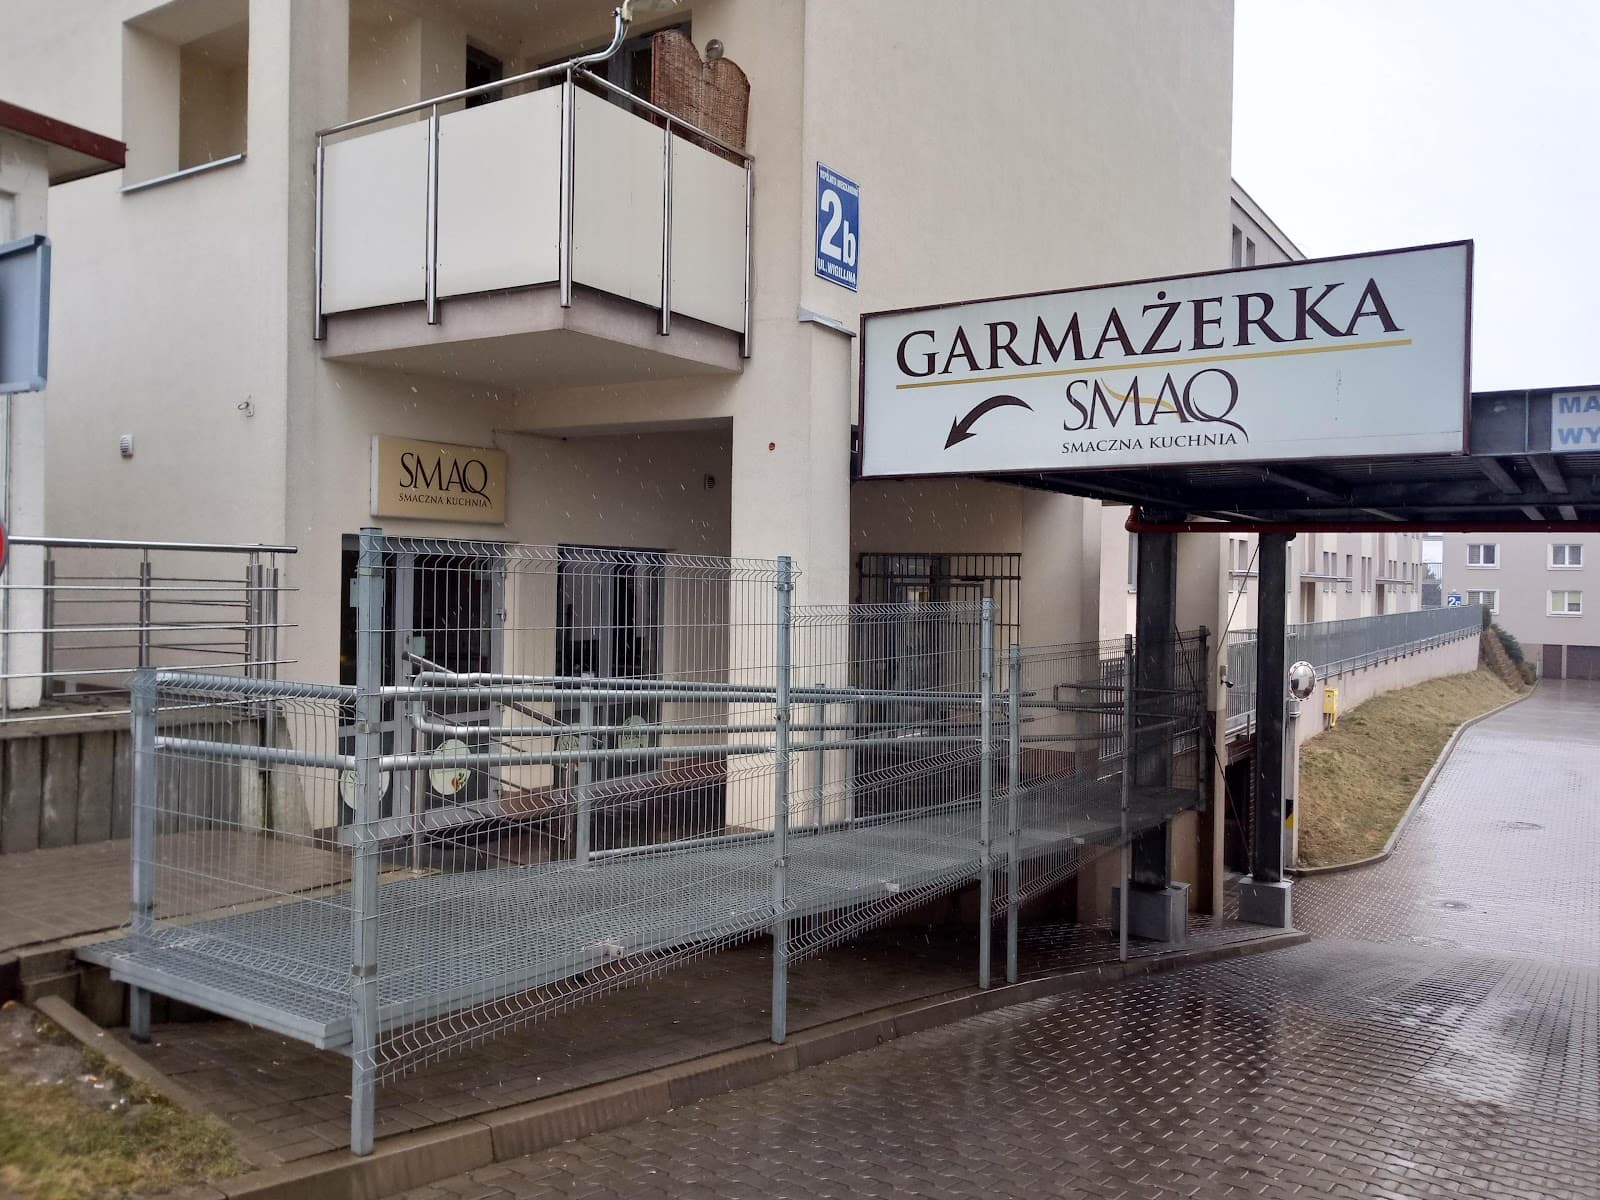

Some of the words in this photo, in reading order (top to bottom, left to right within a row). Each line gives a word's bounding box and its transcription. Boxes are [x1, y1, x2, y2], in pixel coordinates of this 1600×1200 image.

[821, 189, 856, 267] 2b
[896, 277, 1404, 377] GARMAŻERKA
[1063, 368, 1249, 443] SMAQ
[1062, 438, 1143, 454] SMACZNA
[1150, 432, 1237, 449] KUCHNIA
[399, 452, 493, 509] SMAQ
[399, 493, 443, 505] SMACZNA
[446, 496, 488, 508] KUCHNIA
